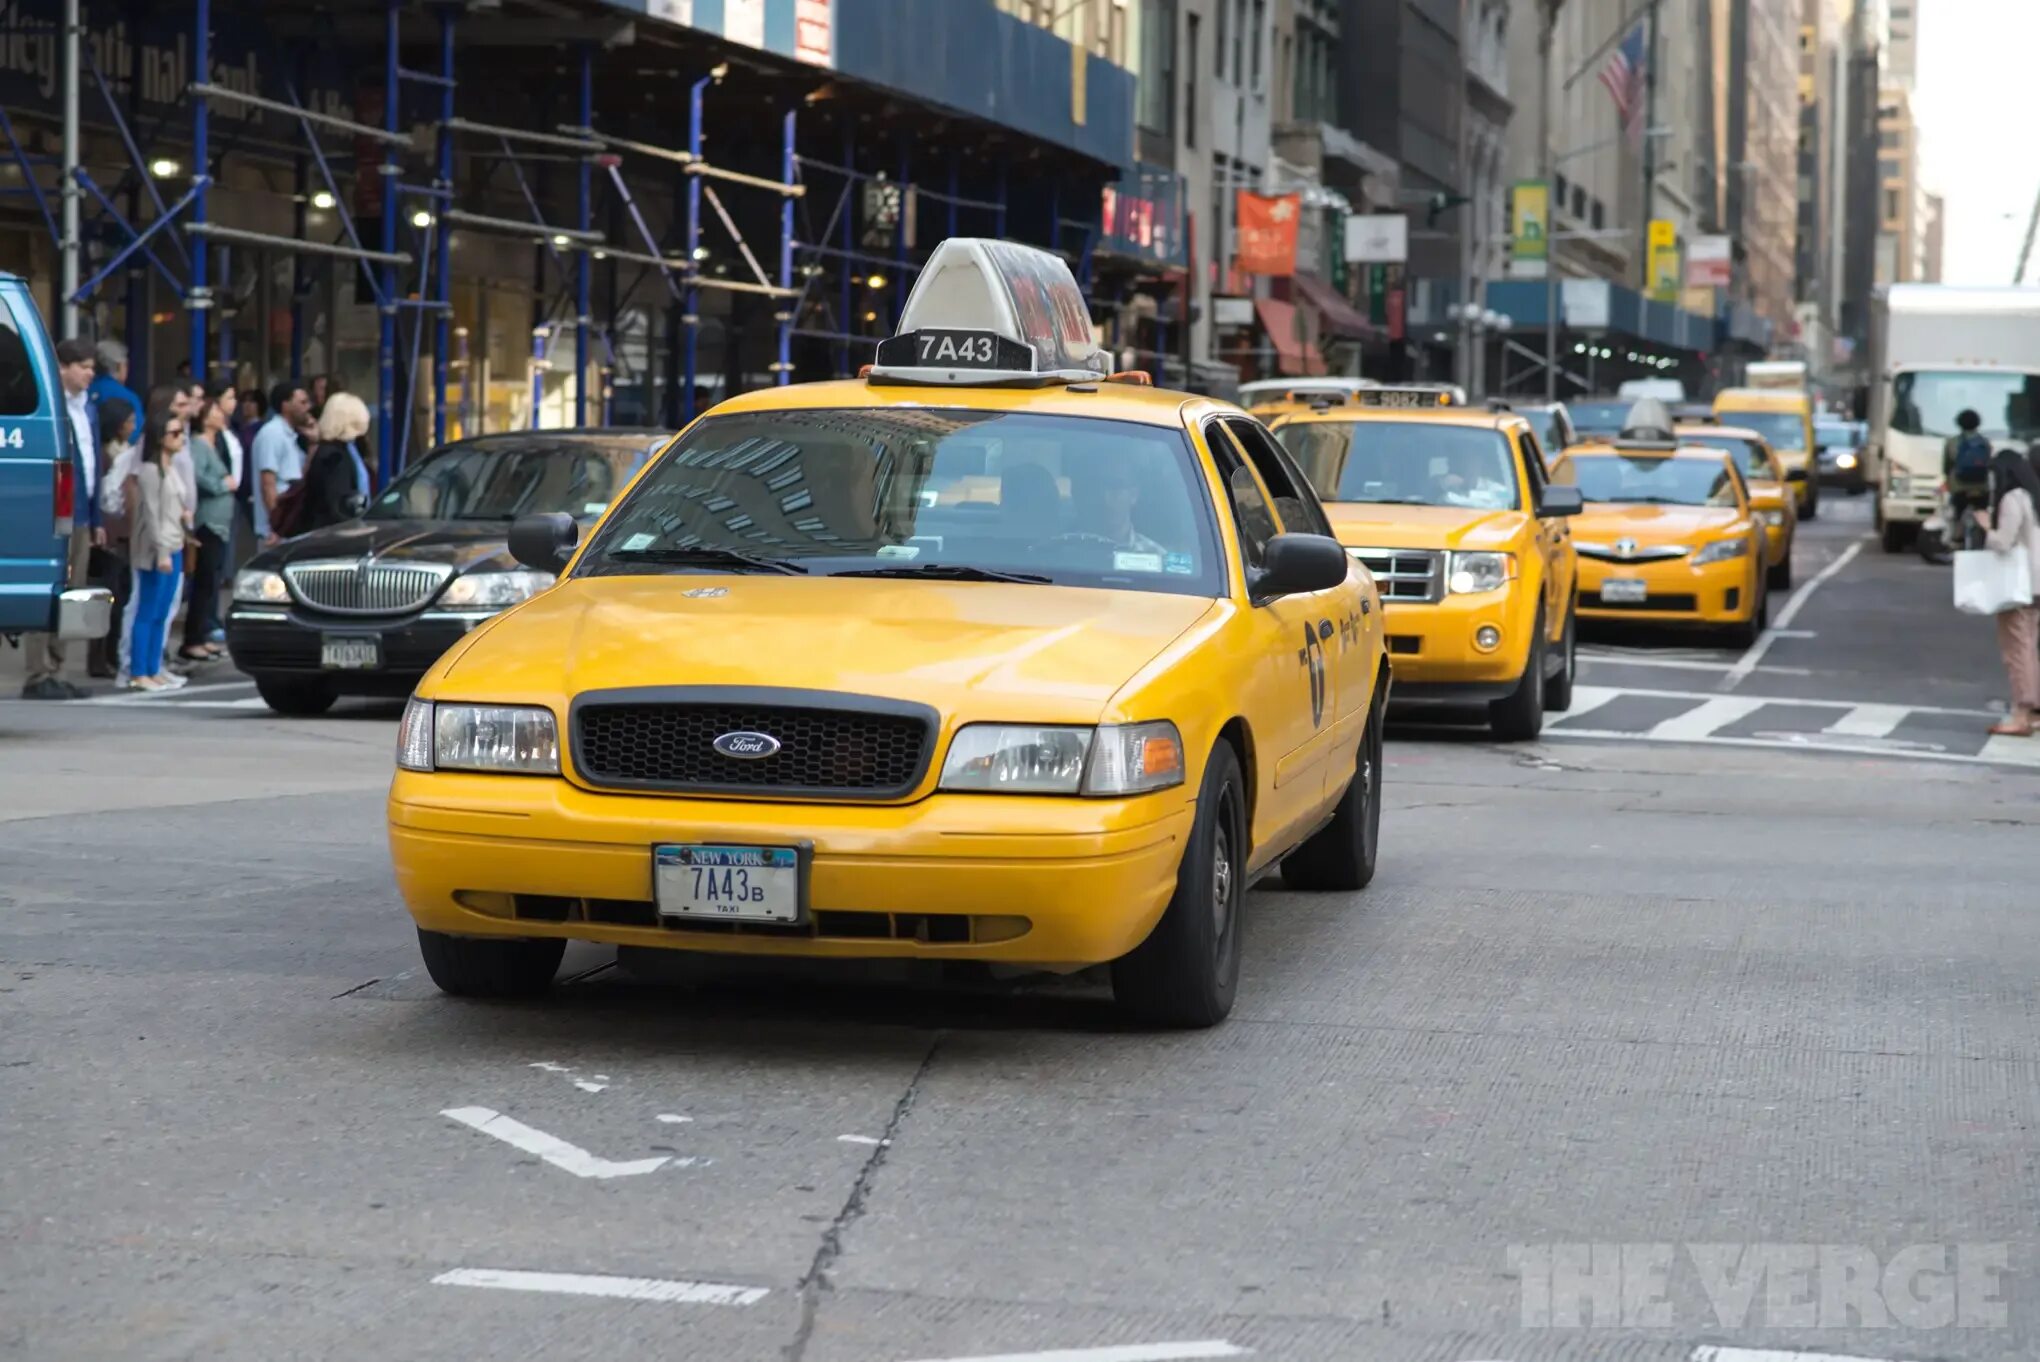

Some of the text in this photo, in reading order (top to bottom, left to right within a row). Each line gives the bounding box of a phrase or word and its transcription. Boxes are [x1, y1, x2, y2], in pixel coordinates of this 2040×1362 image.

[920, 335, 993, 362] 7A43
[729, 736, 763, 752] Ford
[691, 851, 762, 866] NEW YORK
[717, 905, 739, 913] TAXI
